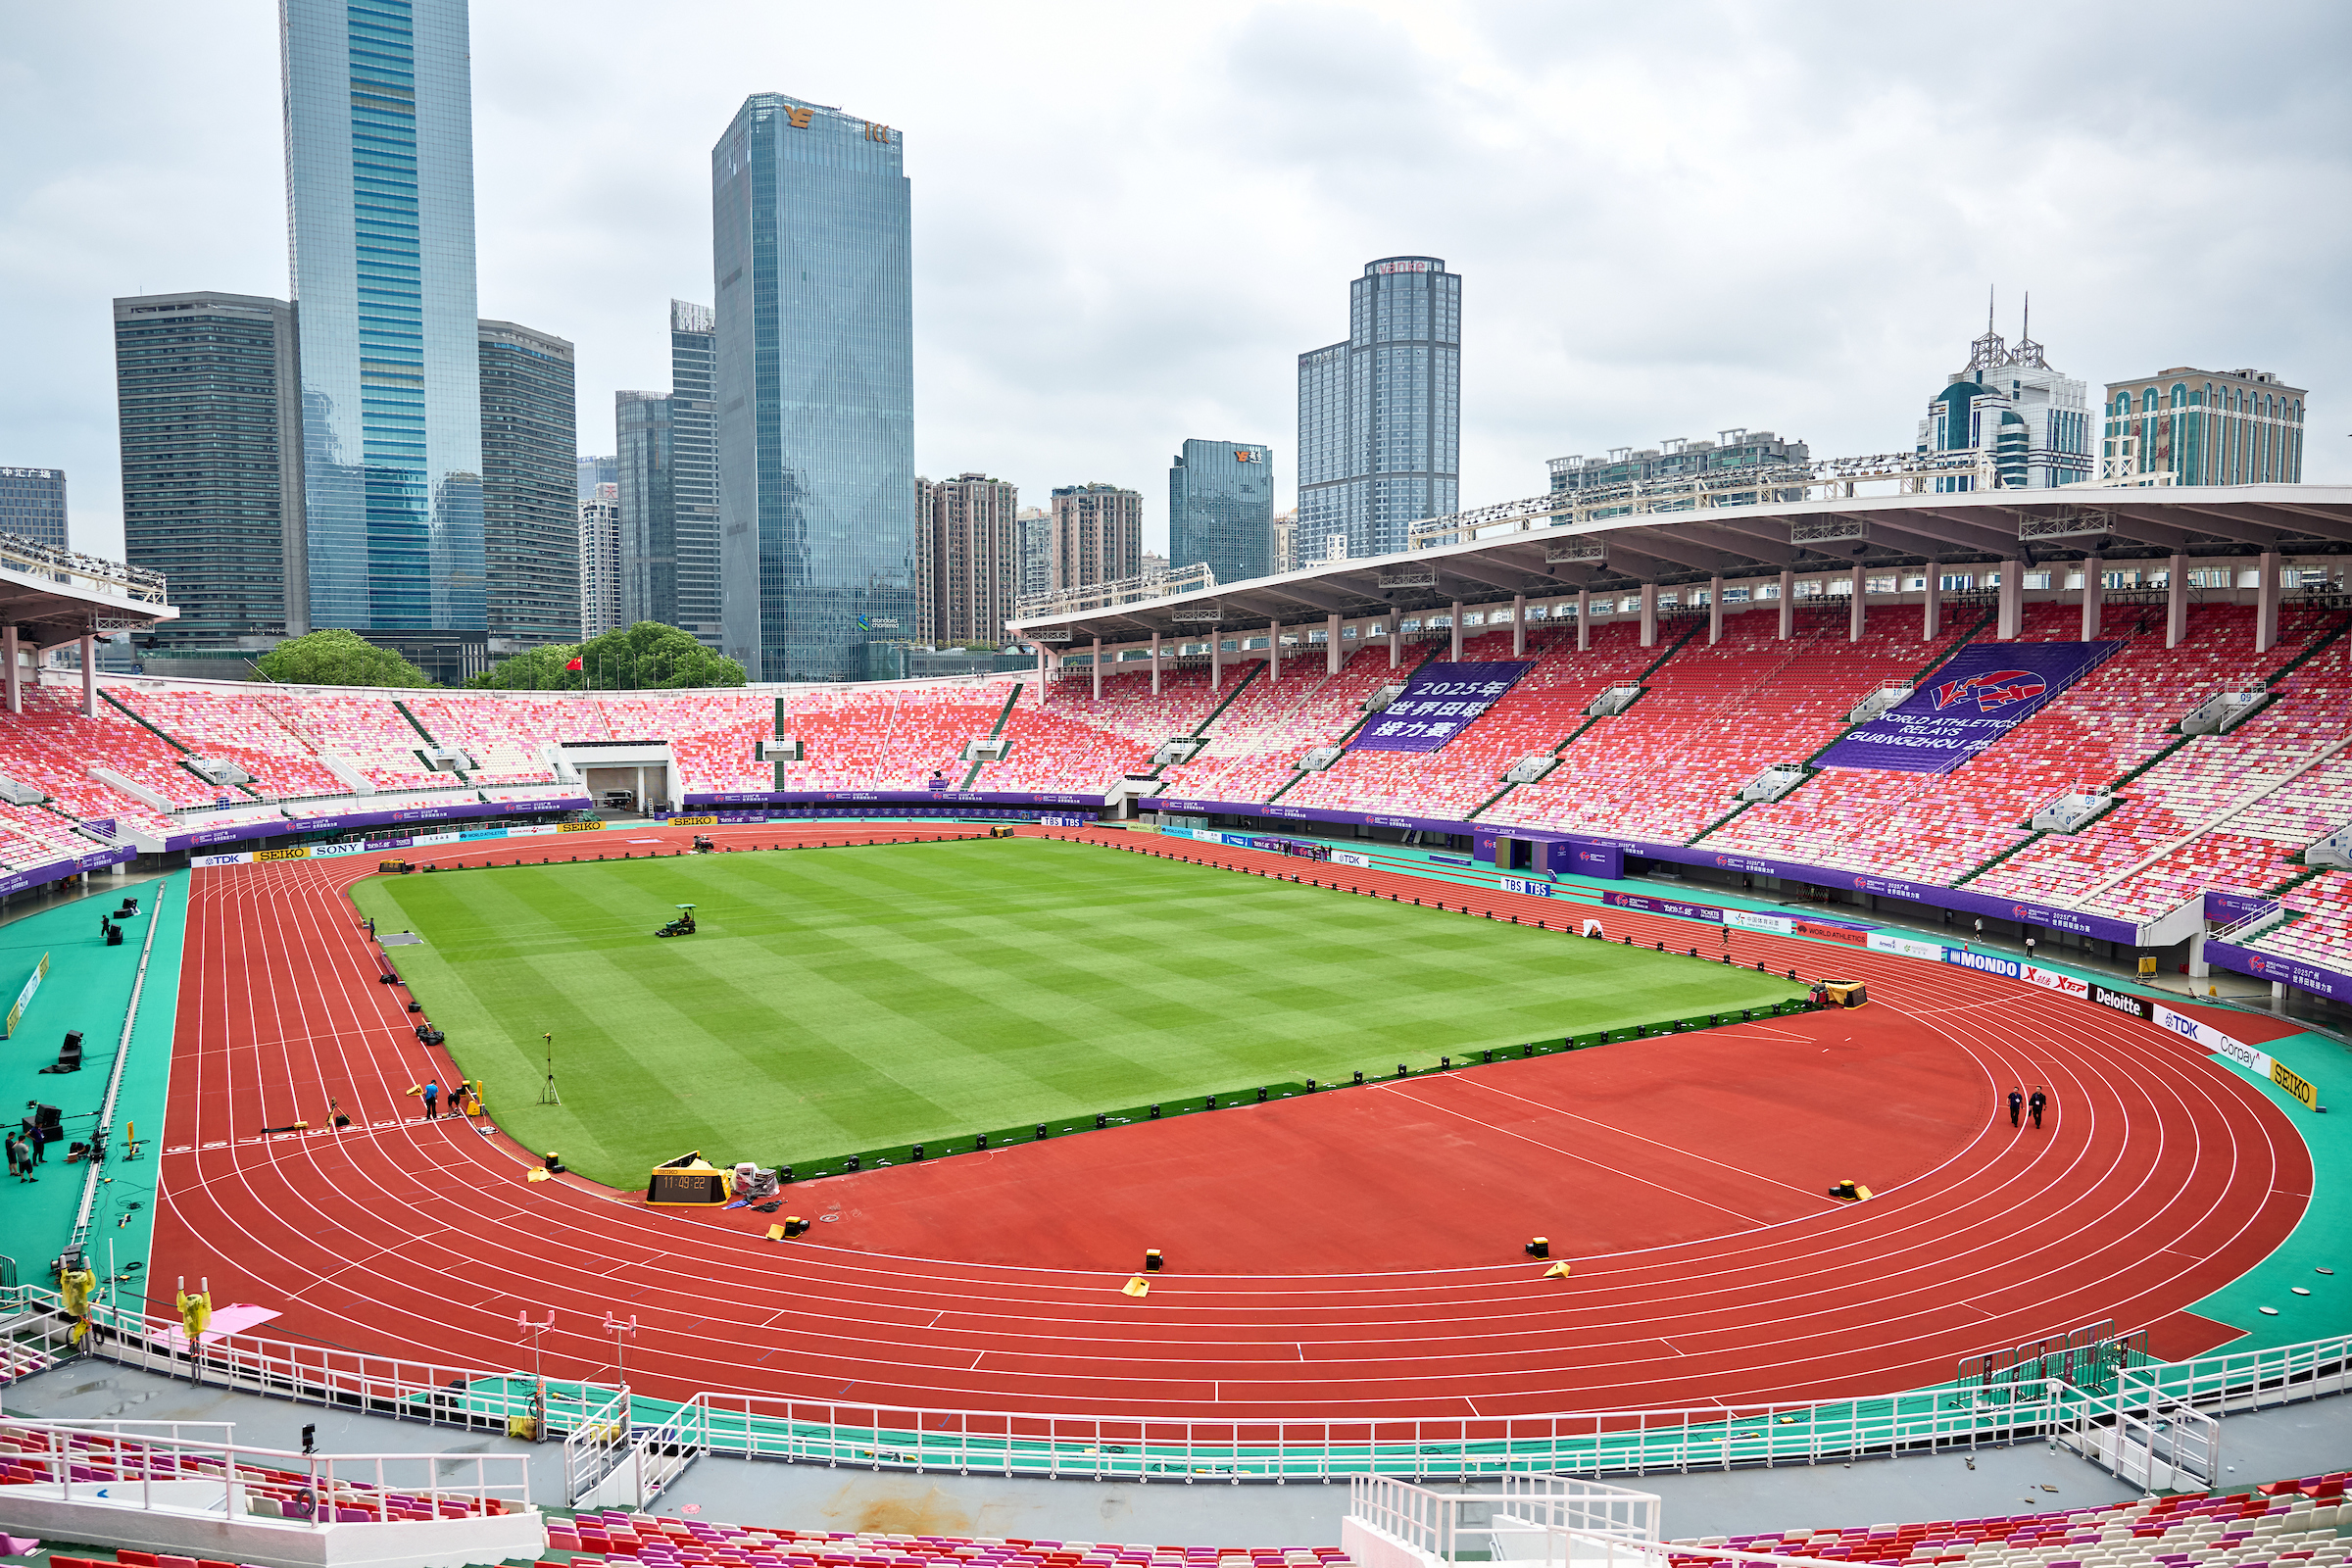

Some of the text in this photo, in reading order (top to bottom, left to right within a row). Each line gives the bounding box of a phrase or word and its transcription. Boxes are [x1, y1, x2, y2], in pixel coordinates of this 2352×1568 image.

[865, 121, 890, 144] ICC
[1380, 261, 1425, 274] vanke
[1413, 680, 1509, 697] 2025年
[2240, 693, 2252, 702] 09
[1371, 720, 1457, 737] 接力赛
[1931, 717, 2022, 728] ATHLETICS
[1898, 725, 1963, 736] RELAYS
[1845, 731, 1966, 750] GUANGZHOU
[2084, 796, 2095, 805] 09
[563, 821, 601, 832] SEIKO
[674, 816, 711, 826] SEIKO
[260, 848, 304, 861] SEIKO
[317, 844, 359, 856] SONY
[216, 855, 239, 864] TDK
[1344, 855, 1360, 865] TDK
[1505, 878, 1546, 896] TBS TBS
[1746, 916, 1779, 926] 中国体育彩票
[2052, 912, 2078, 922] 2025广州
[1809, 928, 1866, 943] WORLD ATHLETICS
[1960, 951, 2017, 977] MONDO
[2293, 967, 2321, 980] 2025广州
[2053, 975, 2087, 994] XTEP
[2292, 975, 2332, 994] 世界田联接力赛
[2173, 1014, 2199, 1040] TDK
[2220, 1036, 2256, 1069] Corpay
[2275, 1062, 2310, 1103] SEIKO
[663, 1176, 706, 1189] 11:49:22
